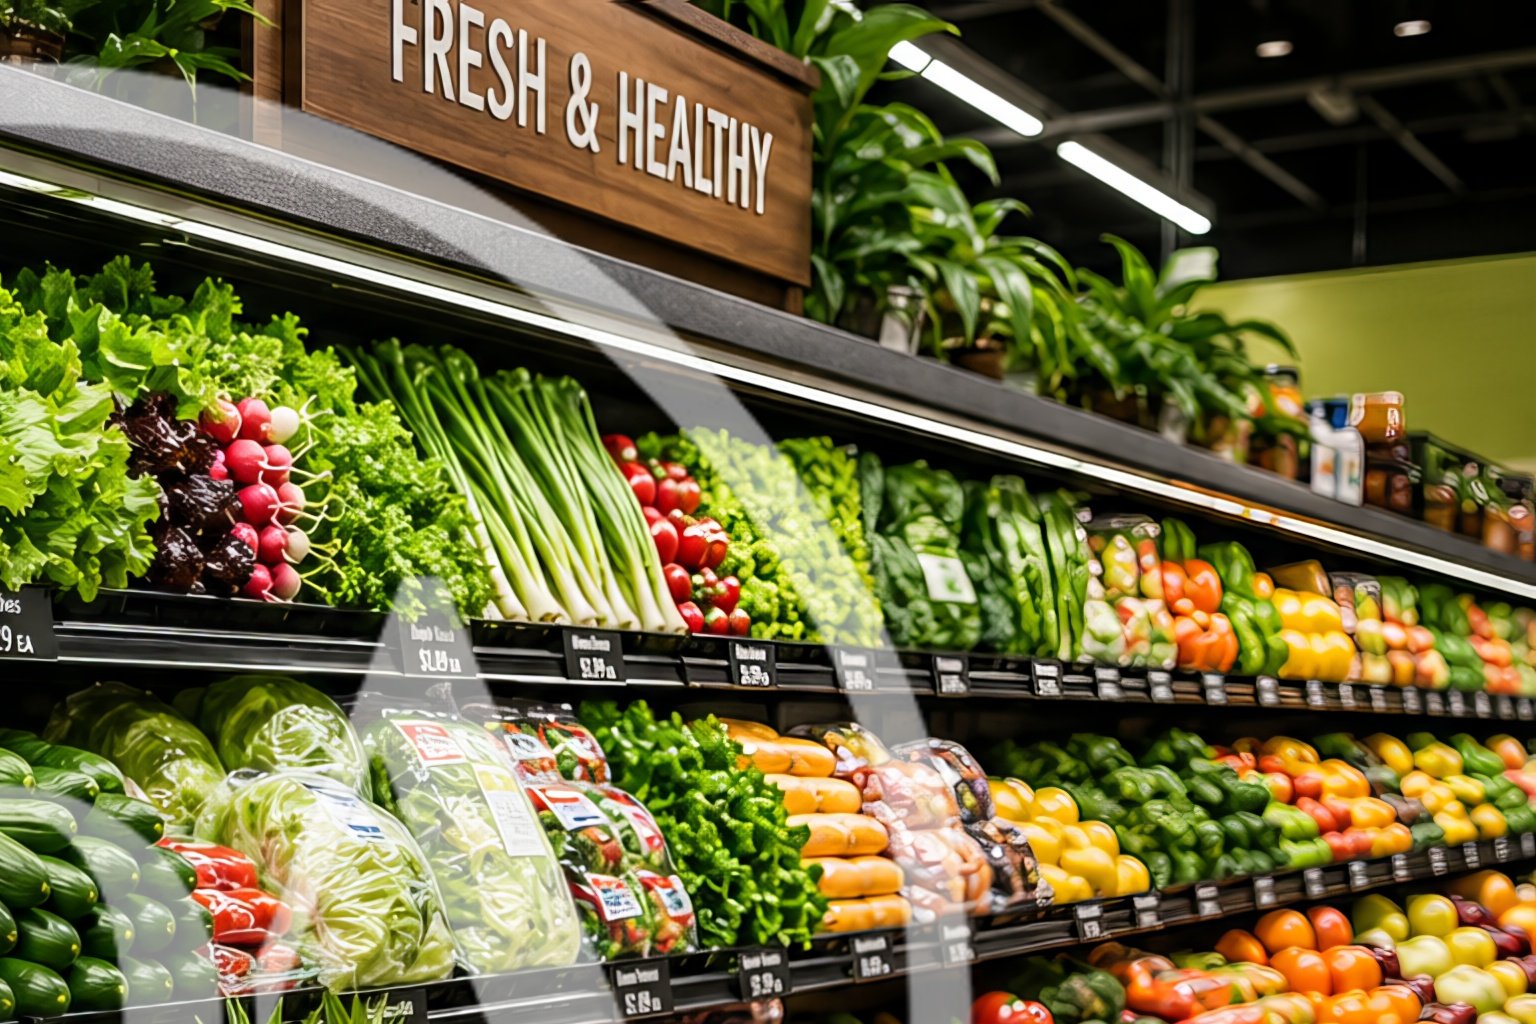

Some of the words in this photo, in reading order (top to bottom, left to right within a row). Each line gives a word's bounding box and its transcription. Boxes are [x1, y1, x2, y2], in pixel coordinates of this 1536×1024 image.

[391, 0, 547, 135] FRESH
[565, 52, 600, 154] &
[617, 70, 773, 216] HEALTHY
[16, 634, 34, 654] EA
